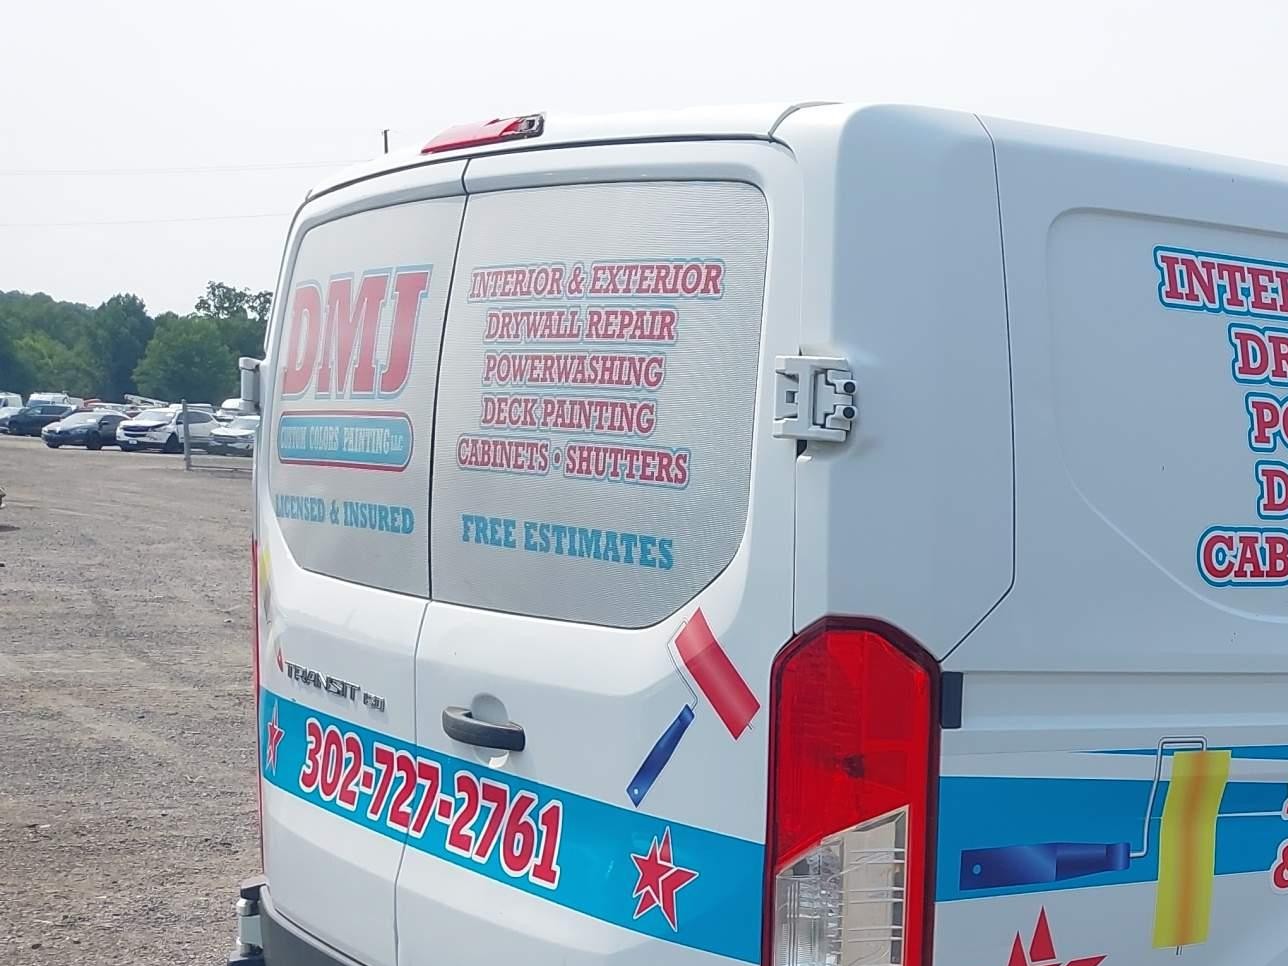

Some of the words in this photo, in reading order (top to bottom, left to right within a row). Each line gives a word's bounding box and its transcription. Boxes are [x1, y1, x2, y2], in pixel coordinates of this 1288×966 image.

[469, 267, 562, 299] INTERIOR
[568, 266, 583, 292] &
[589, 263, 724, 296] EXTERIOR
[282, 264, 433, 399] DMJ
[485, 310, 580, 340] DRYWALL
[585, 310, 676, 341] REPAIR
[483, 355, 663, 387] POWERWASHING
[481, 399, 537, 427] DECK
[541, 402, 656, 433] PAINTING
[309, 426, 339, 451] COLORS
[342, 427, 390, 455] PAINTING
[457, 437, 548, 471] CABINETS
[565, 447, 688, 484] SHUTTERS
[275, 494, 325, 522] LICENSED
[329, 499, 339, 525] &
[343, 501, 415, 534] INSURED
[461, 515, 517, 549] FREE
[523, 522, 674, 570] ESTIMATES
[285, 660, 361, 700] TRANSIT
[299, 718, 563, 889] 302-727-2761
